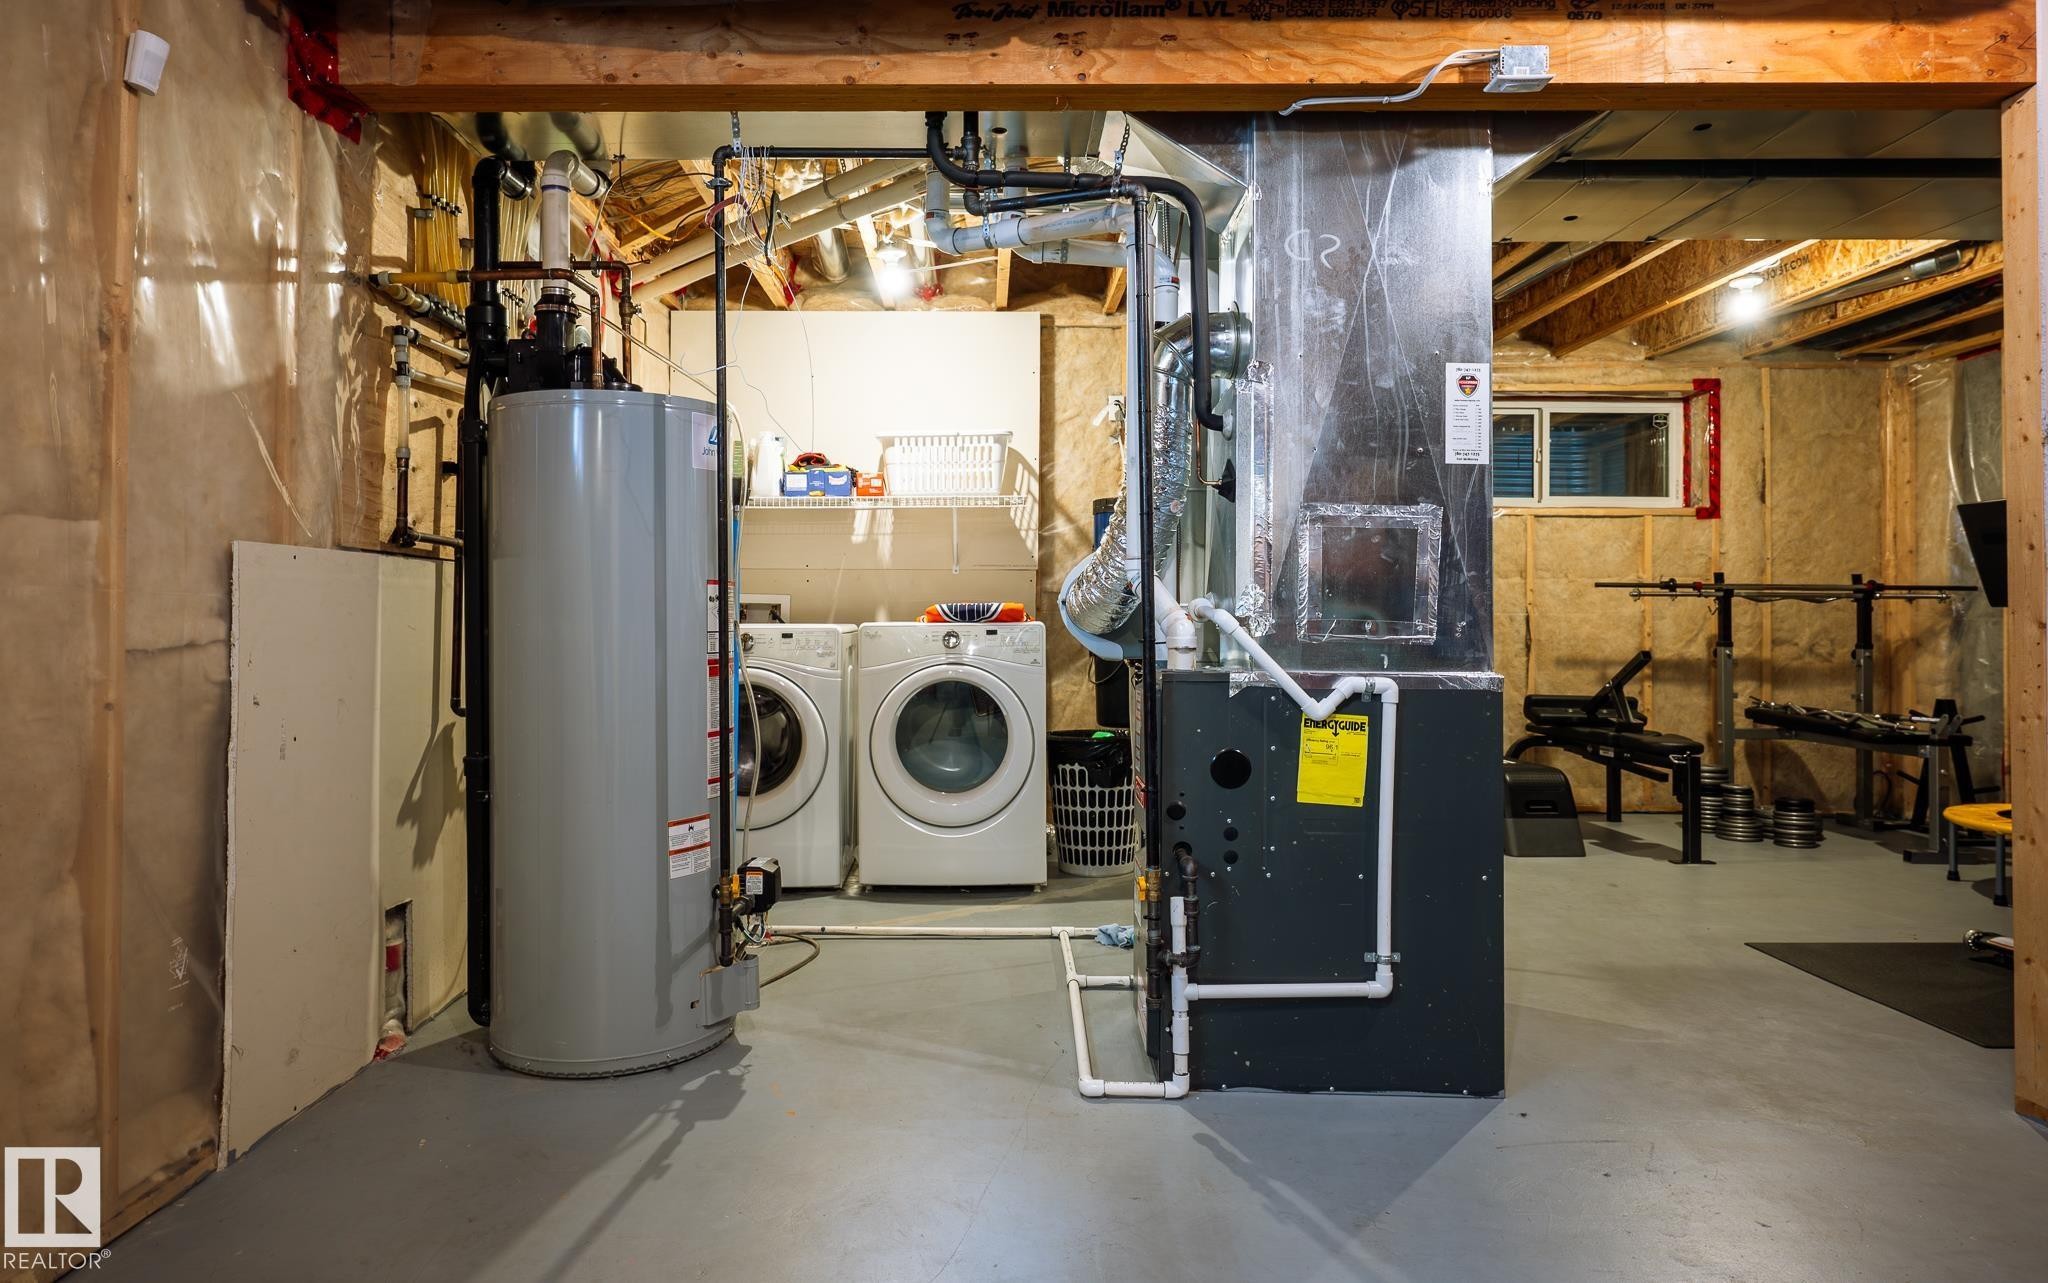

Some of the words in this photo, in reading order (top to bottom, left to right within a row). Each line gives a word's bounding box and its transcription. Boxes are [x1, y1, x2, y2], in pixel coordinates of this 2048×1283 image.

[1187, 0, 1235, 18] LVL
[1286, 8, 1325, 18] CCMC
[1409, 0, 1441, 18] SFI
[702, 446, 716, 456] John
